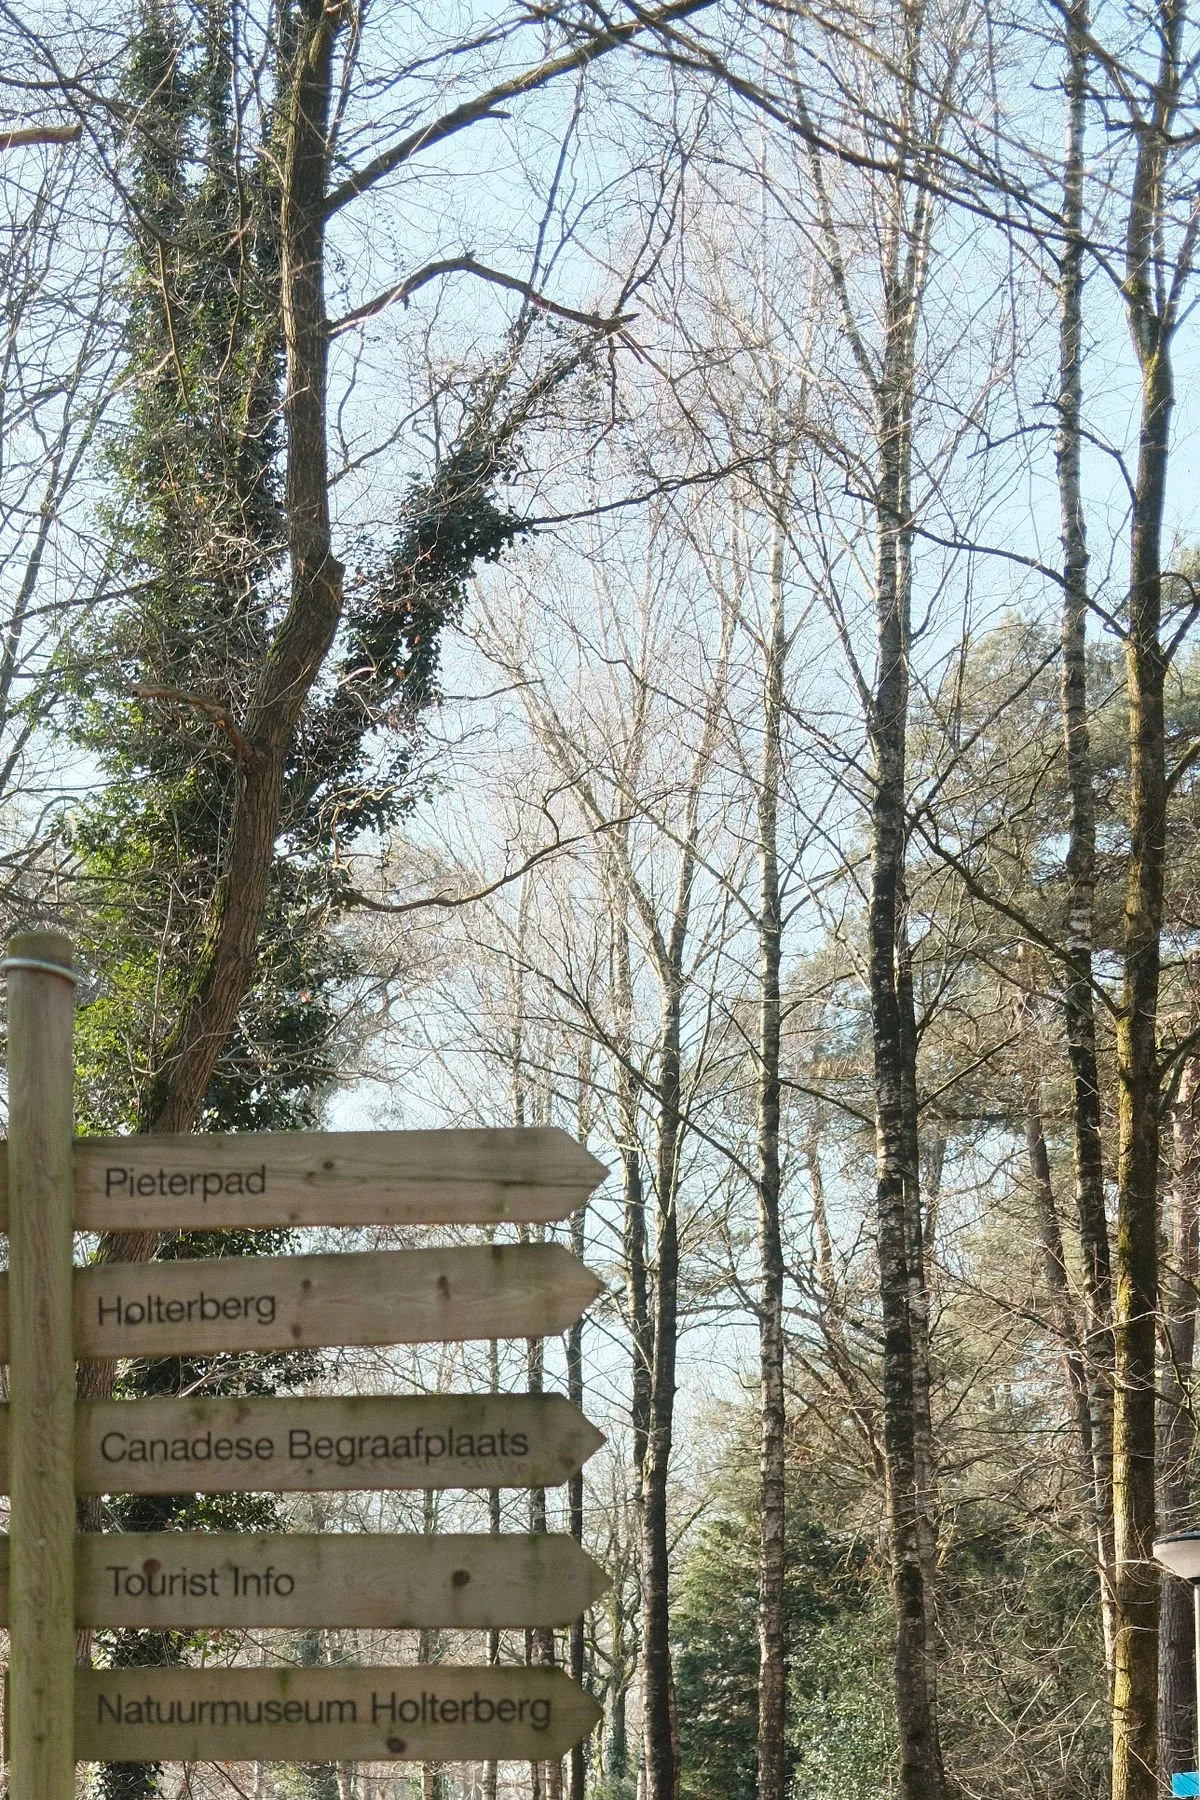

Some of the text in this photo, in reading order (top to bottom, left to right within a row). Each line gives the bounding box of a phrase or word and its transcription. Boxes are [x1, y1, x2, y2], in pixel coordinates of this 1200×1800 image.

[104, 1164, 267, 1203] Pieterpad
[97, 1292, 277, 1327] Holterberg
[100, 1426, 530, 1467] Canadese Begraafplaats
[106, 1565, 296, 1598] Tourist Info
[98, 1690, 552, 1731] Natuurmuseum Holterberg
